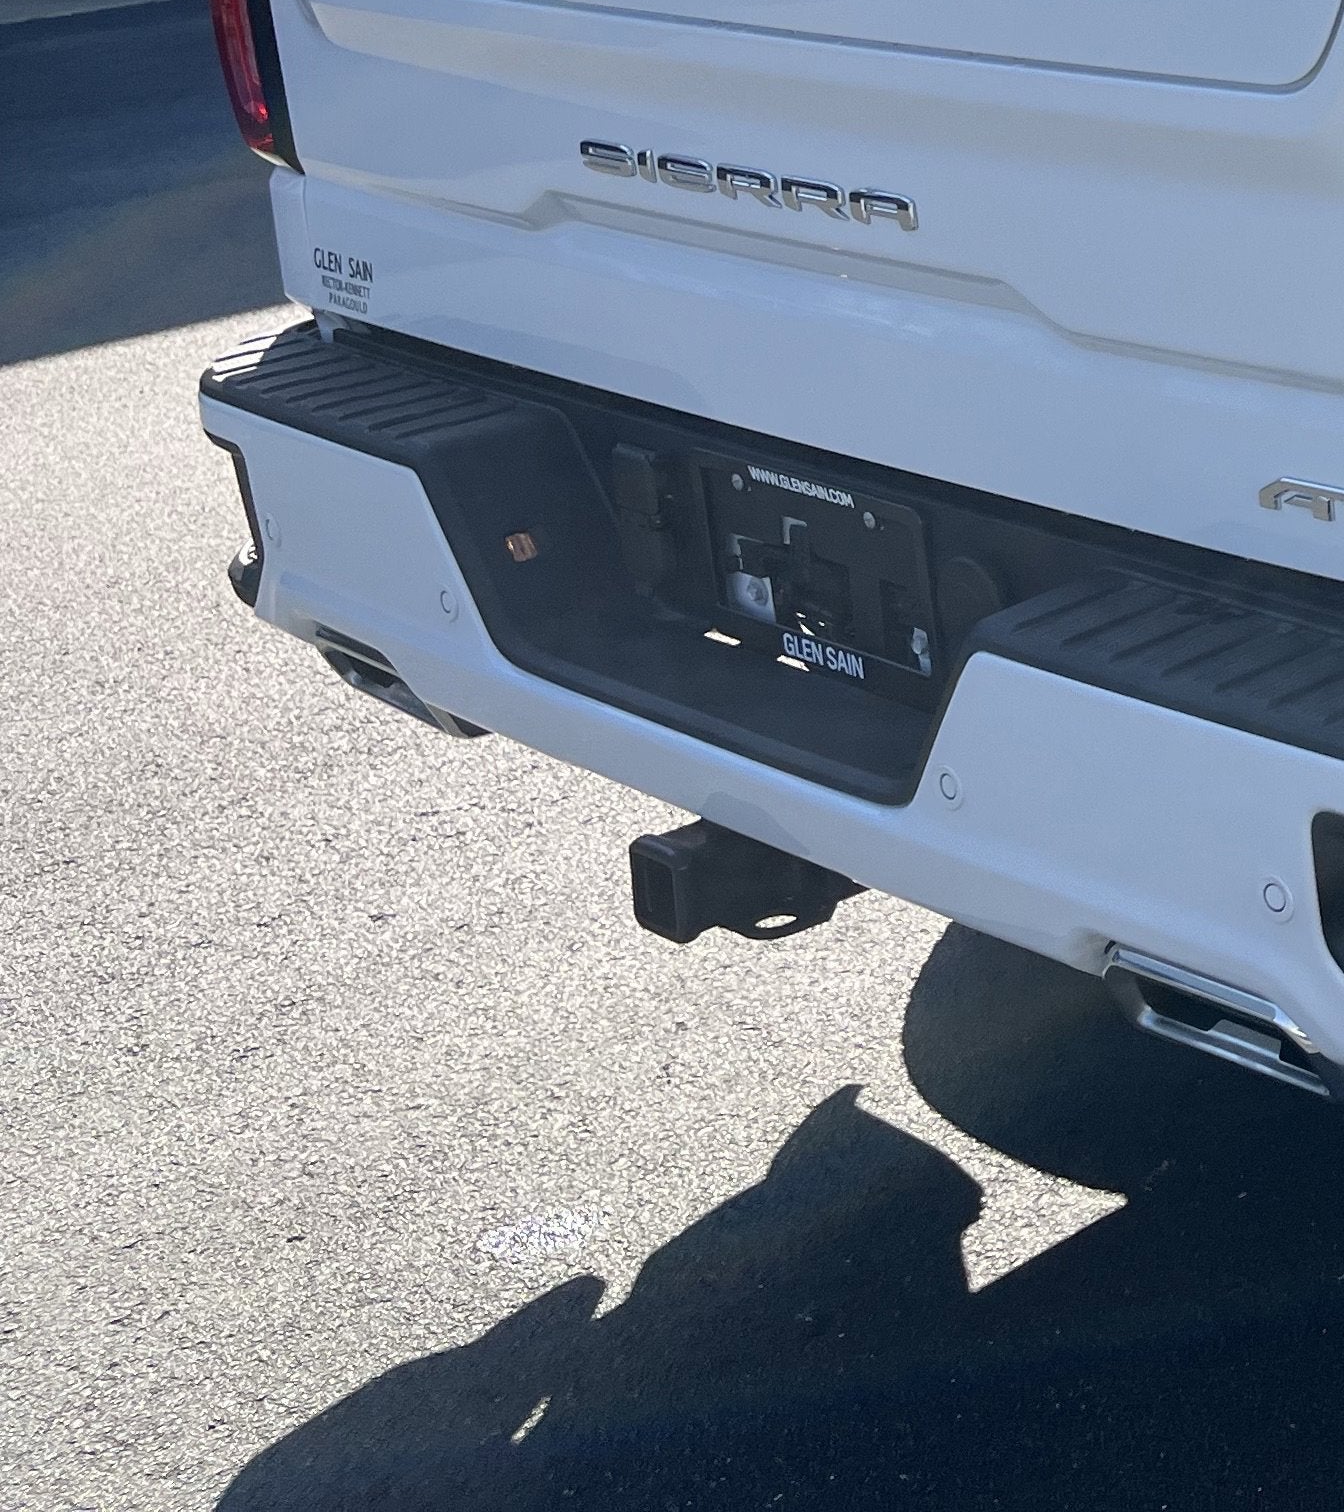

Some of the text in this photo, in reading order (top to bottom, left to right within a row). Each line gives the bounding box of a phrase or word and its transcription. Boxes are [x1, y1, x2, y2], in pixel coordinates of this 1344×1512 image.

[579, 138, 919, 232] SIERRA
[313, 247, 374, 284] GLEN SAIN
[746, 464, 855, 509] WWW.GLENSAIN.COM
[782, 632, 865, 680] GLEN SAIN
